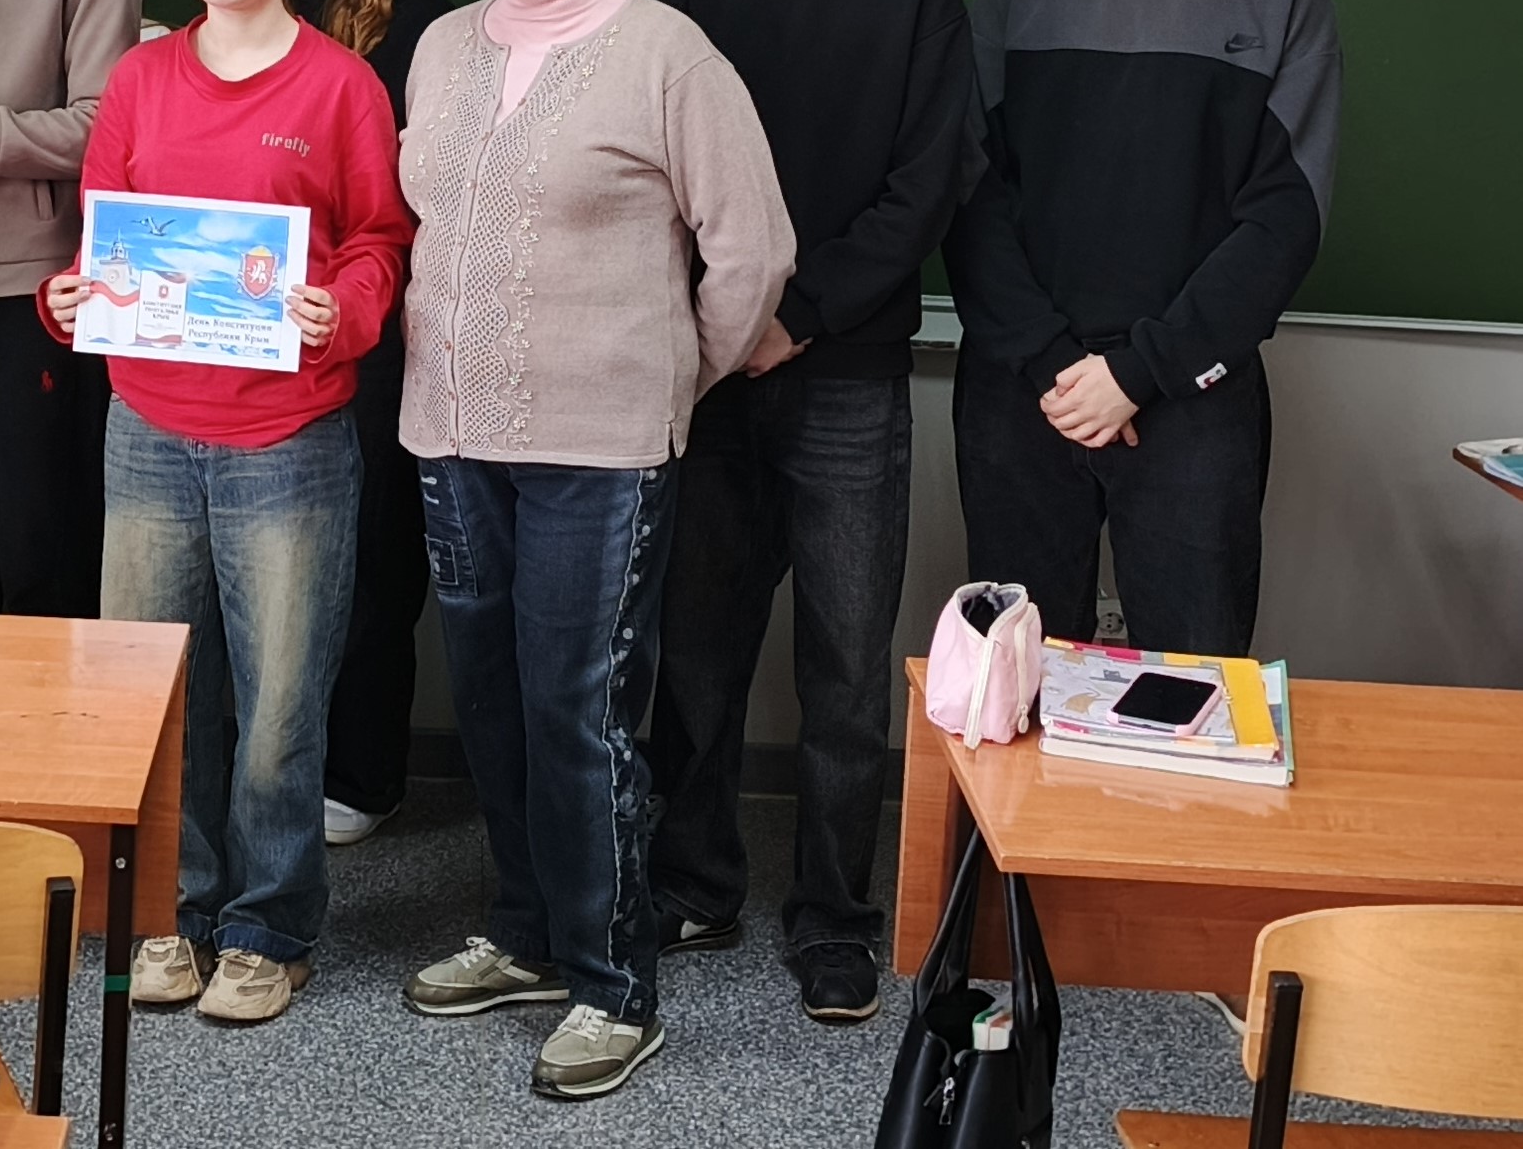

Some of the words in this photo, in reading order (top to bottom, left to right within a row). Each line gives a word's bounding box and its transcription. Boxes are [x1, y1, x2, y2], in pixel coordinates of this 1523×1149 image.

[187, 316, 210, 326] День
[213, 318, 273, 331] Конституции
[188, 328, 240, 341] Республики
[244, 333, 270, 344] Крым
